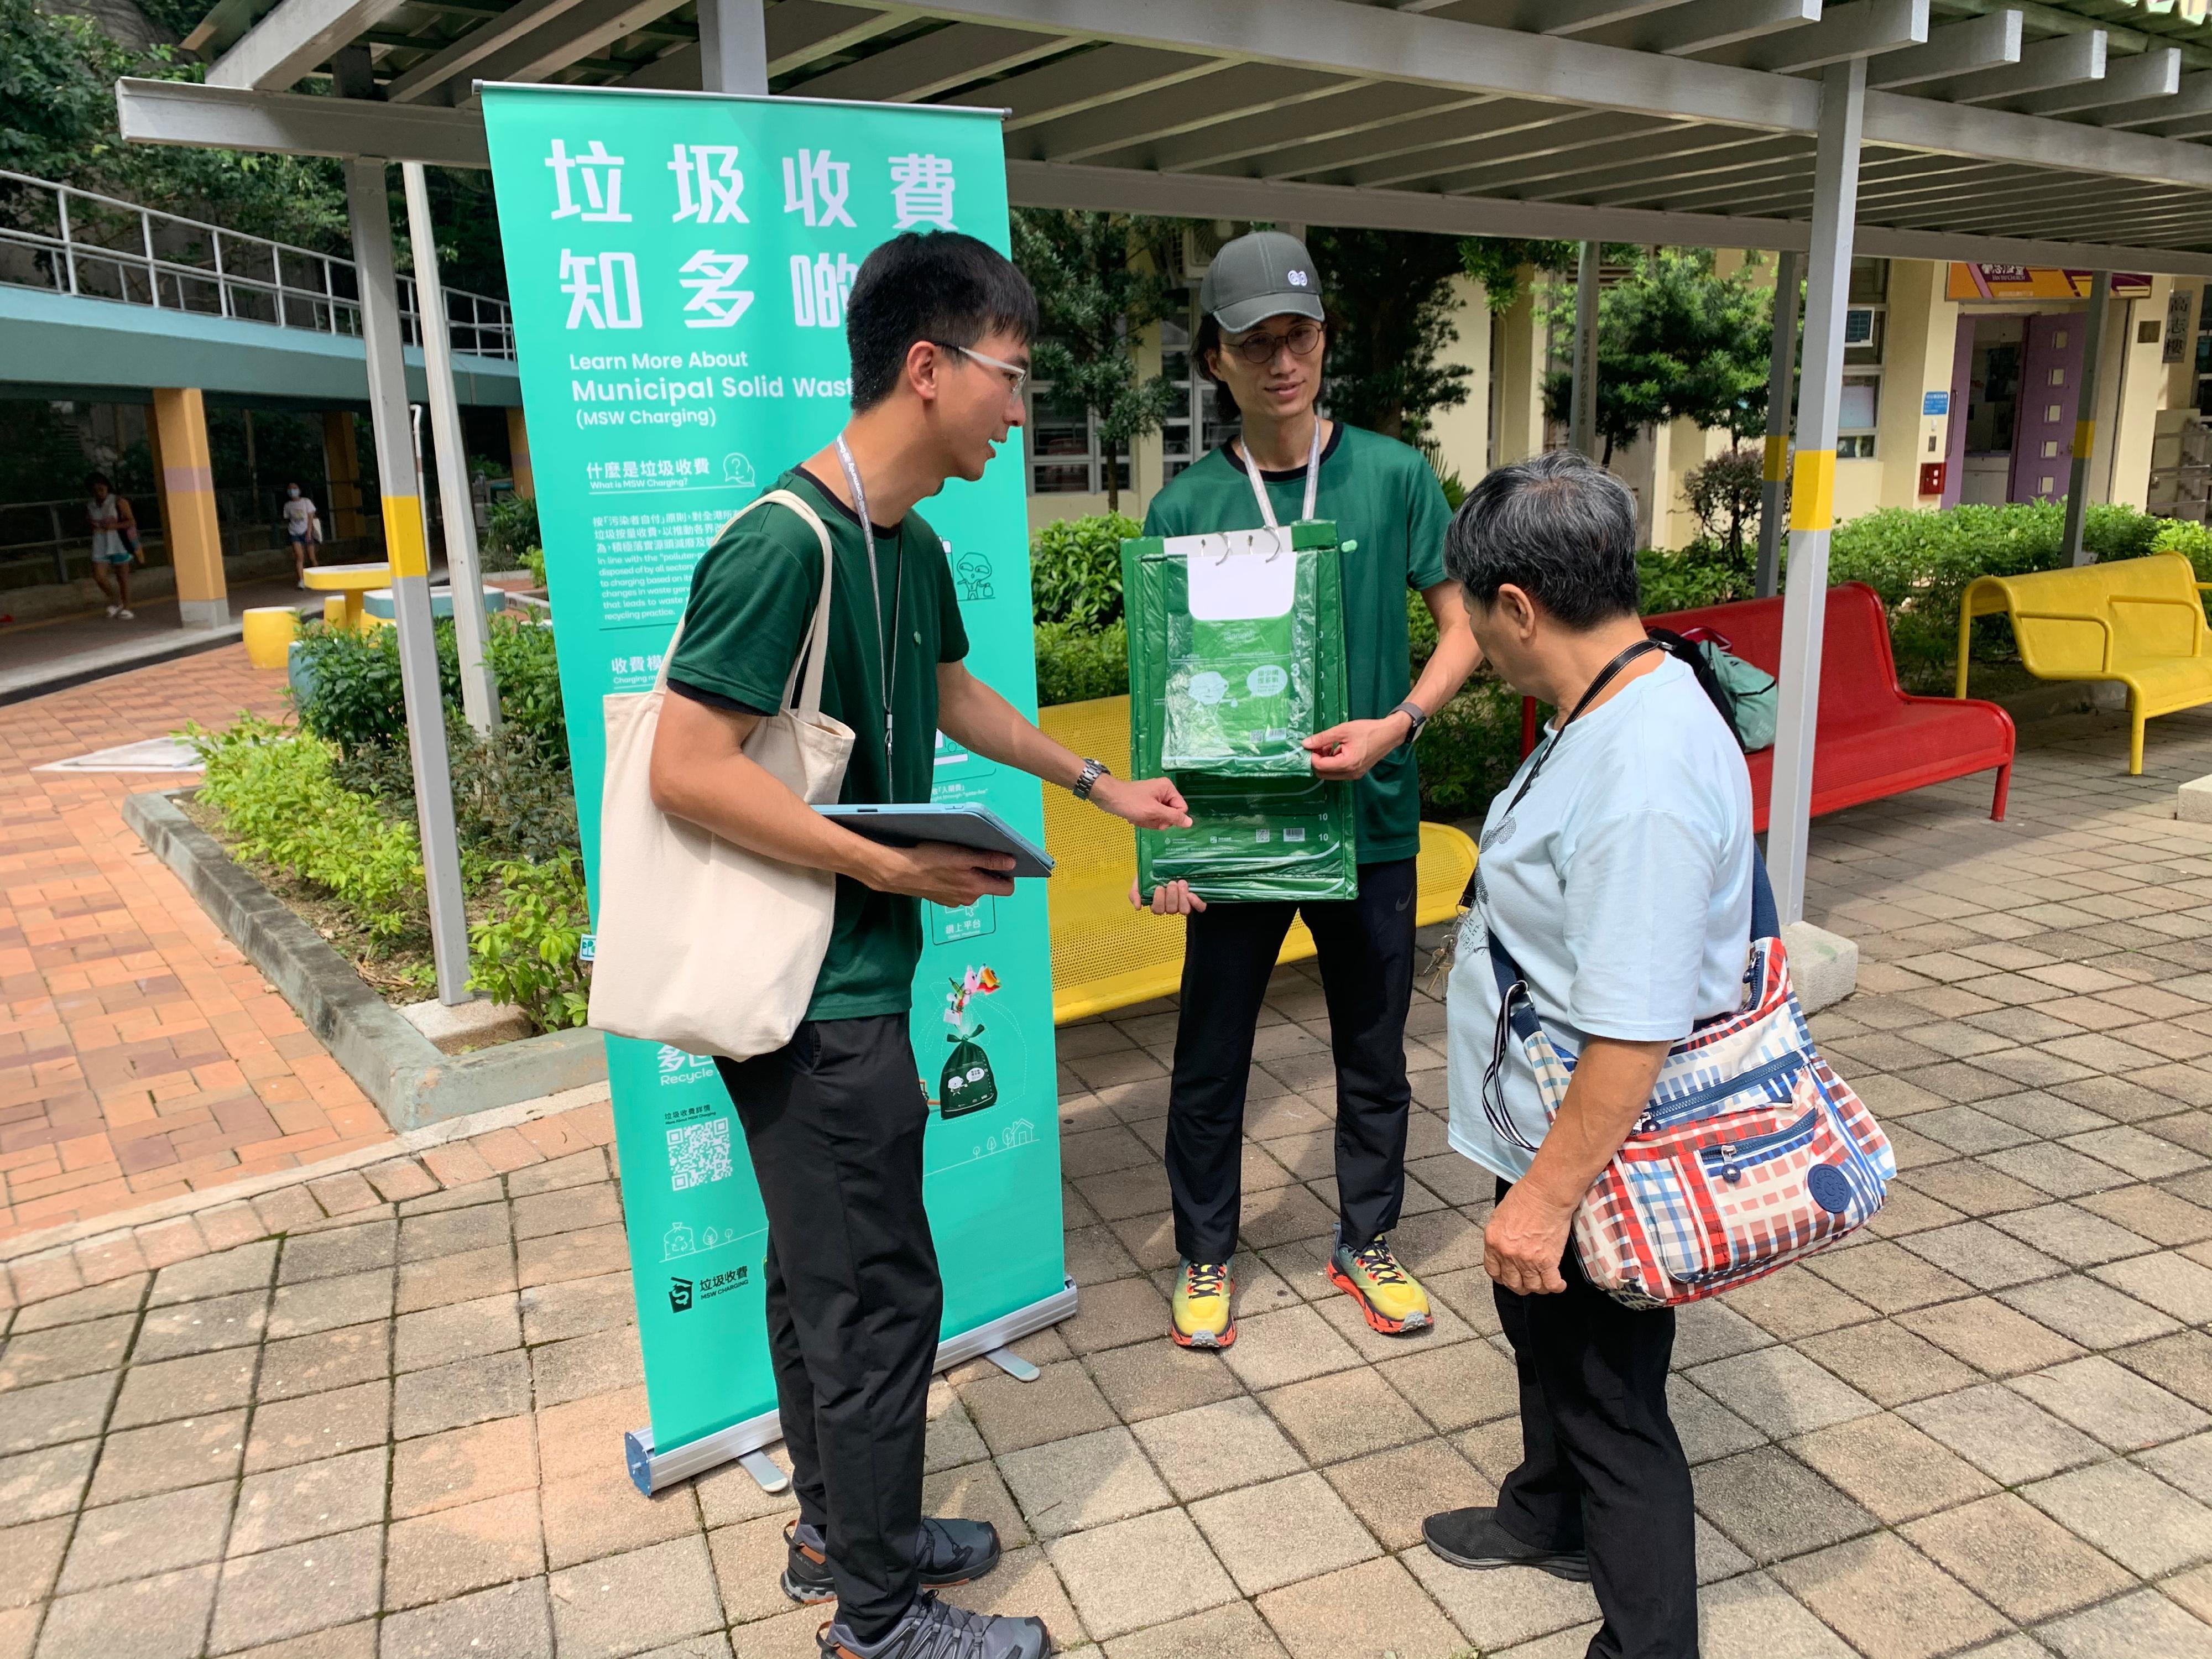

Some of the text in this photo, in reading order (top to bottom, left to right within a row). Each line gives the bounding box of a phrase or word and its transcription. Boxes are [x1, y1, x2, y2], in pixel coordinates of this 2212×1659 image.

[545, 139, 959, 230] 垃圾收費
[570, 351, 748, 370] Learn More About
[572, 375, 853, 406] Municipal Solid Wast
[576, 406, 717, 430] (MSW Charging)
[589, 477, 688, 489] What is MSW Charging?
[608, 555, 623, 564] line
[624, 555, 643, 563] with
[644, 554, 658, 562] the
[598, 567, 634, 577] disposed
[644, 565, 654, 574] by
[610, 578, 645, 587] charging
[646, 575, 671, 584] based
[602, 588, 637, 598] changes
[623, 599, 646, 608] leads
[604, 609, 675, 620] recycling practice.
[611, 654, 662, 674] 收費模
[1291, 662, 1300, 677] 3
[613, 676, 647, 684] Charging
[1318, 813, 1328, 821] 10
[1318, 833, 1329, 841] 10
[660, 1067, 714, 1086] Recycle
[699, 1265, 748, 1292] 垃圾收費
[700, 1279, 749, 1300] MSW CHARGING
